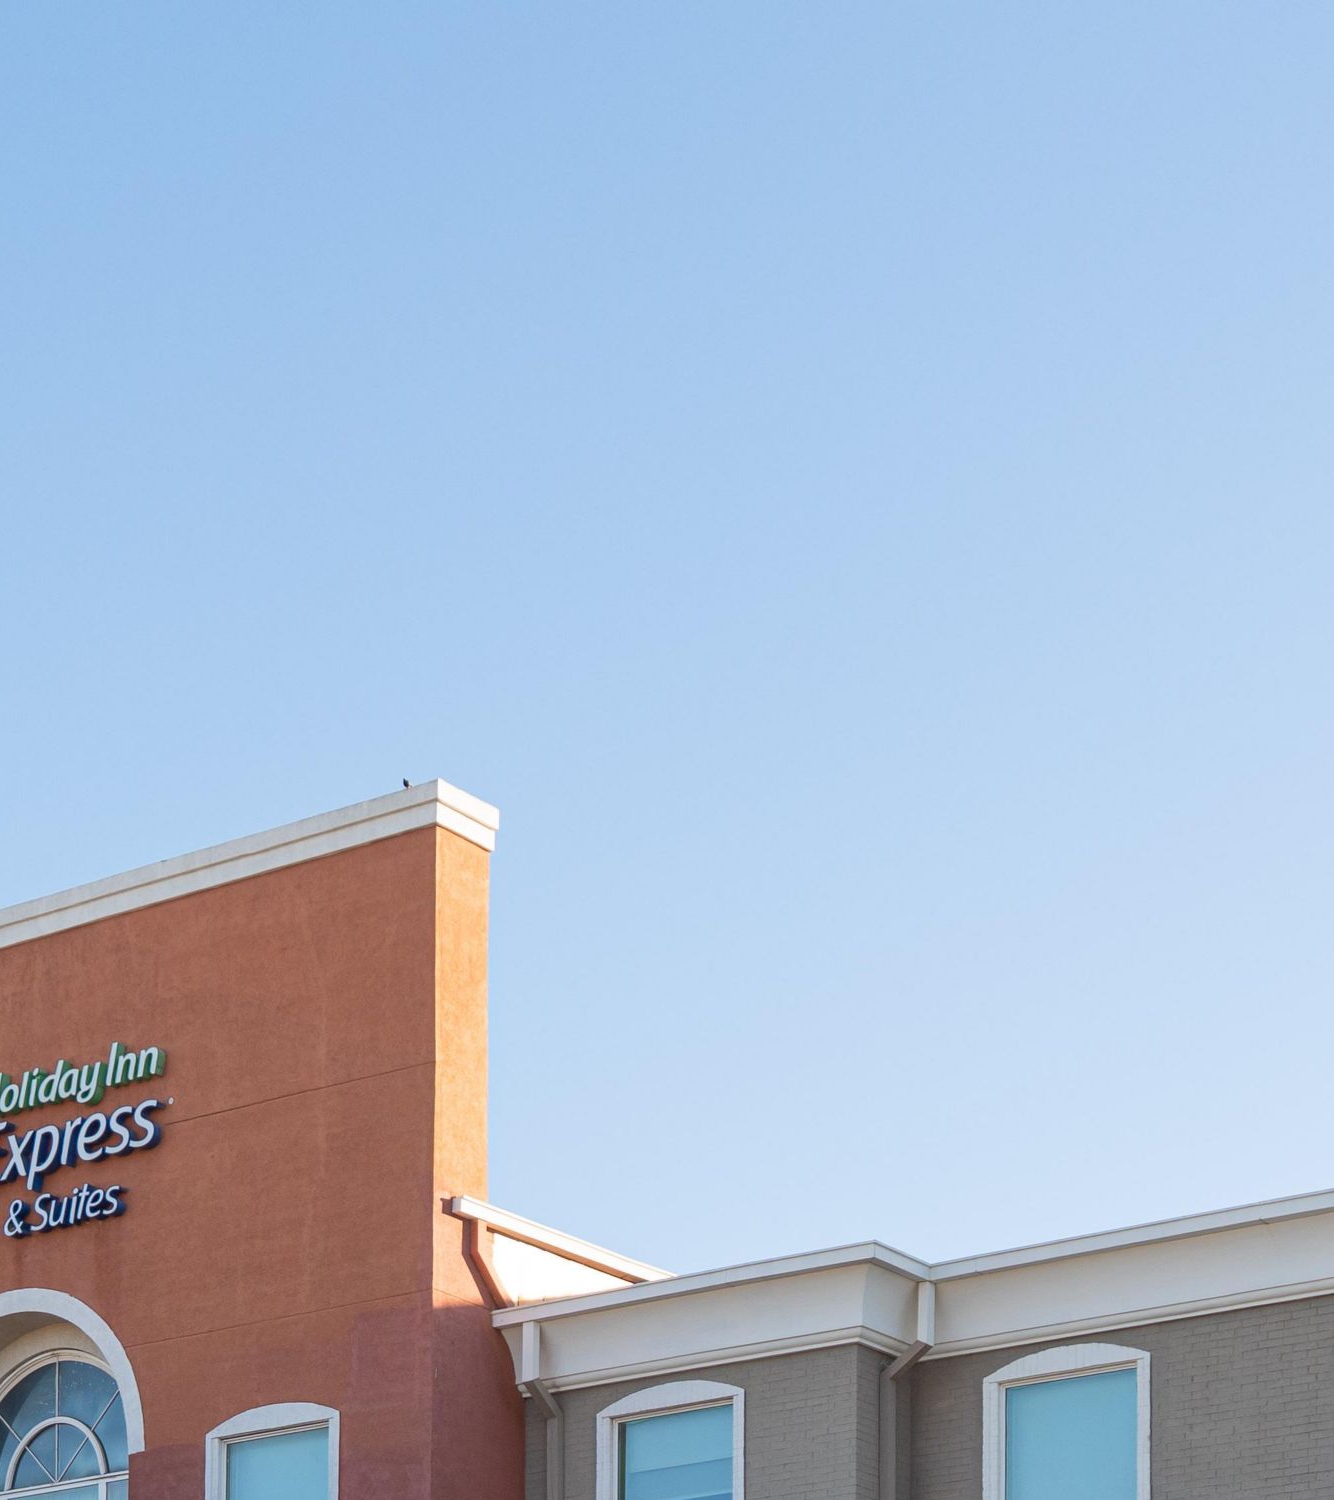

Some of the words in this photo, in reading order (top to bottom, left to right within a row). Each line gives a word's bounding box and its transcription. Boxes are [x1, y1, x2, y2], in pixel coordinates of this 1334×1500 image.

[105, 1040, 161, 1087] Inn
[3, 1198, 24, 1238] &
[29, 1182, 121, 1233] Suites
